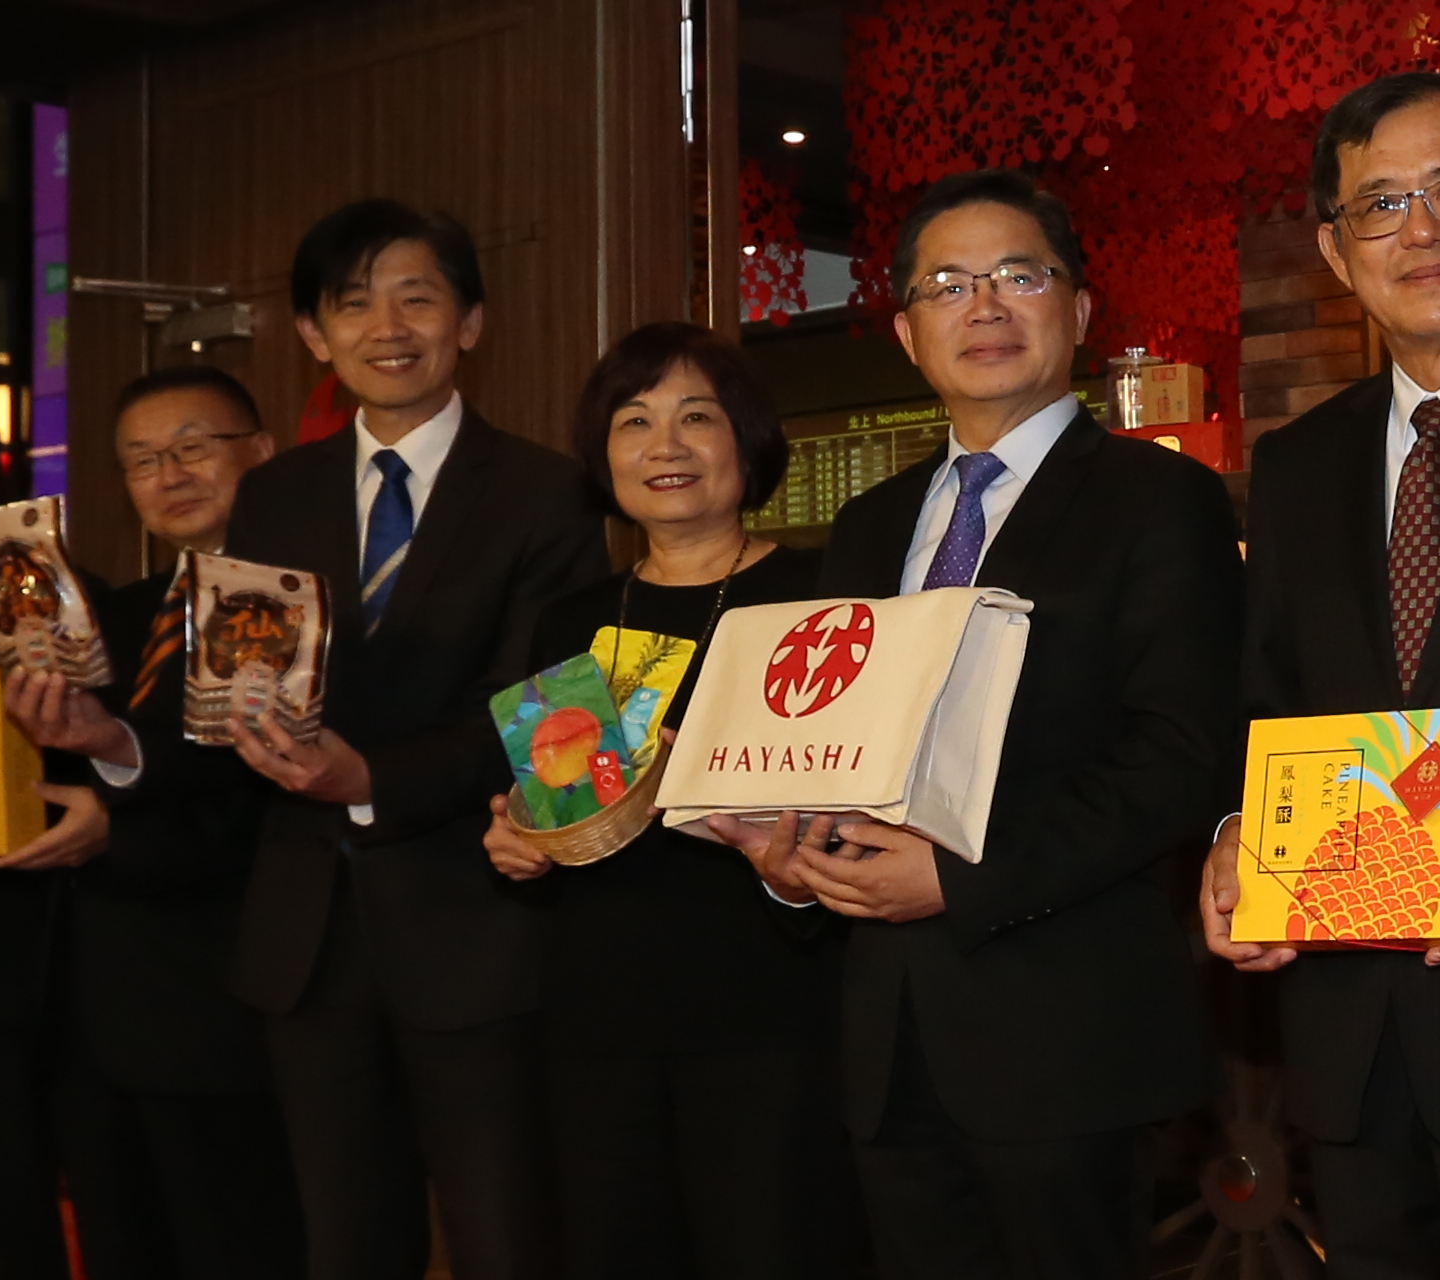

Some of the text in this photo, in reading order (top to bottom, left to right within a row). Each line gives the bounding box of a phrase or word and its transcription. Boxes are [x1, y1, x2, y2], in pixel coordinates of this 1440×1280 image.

[876, 408, 937, 425] Northbound
[708, 743, 865, 773] HAYASHI
[1276, 765, 1295, 824] 鳳梨酥
[1321, 763, 1335, 810] CAKE
[1333, 763, 1352, 862] PINEAPPLE
